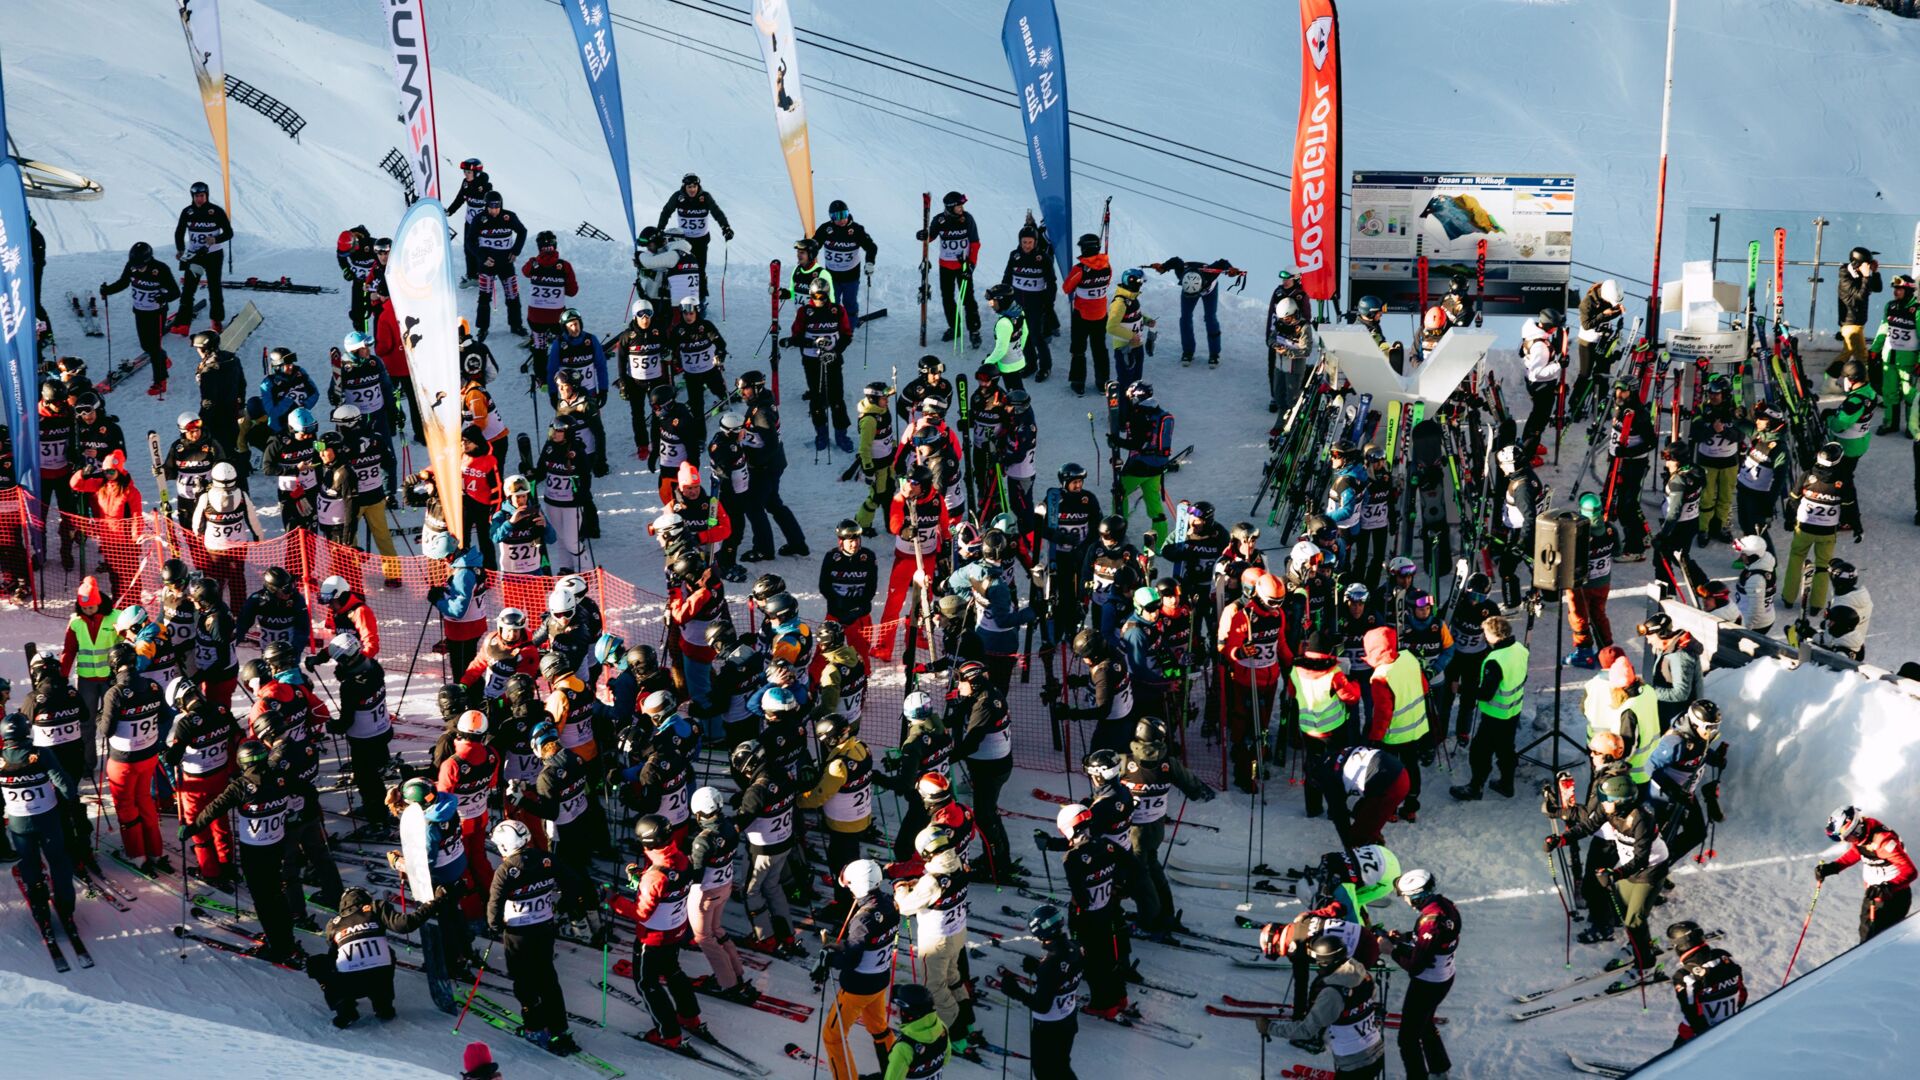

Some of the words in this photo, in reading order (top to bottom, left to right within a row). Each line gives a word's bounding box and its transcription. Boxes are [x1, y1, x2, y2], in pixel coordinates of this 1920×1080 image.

[1423, 176, 1436, 184] Der
[1438, 177, 1460, 185] Ozean
[680, 218, 706, 230] 253
[941, 239, 969, 251] 300
[824, 250, 854, 263] 353
[131, 290, 157, 303] 275
[531, 286, 561, 299] 239
[1672, 340, 1696, 350] Freude
[632, 356, 658, 369] 559
[684, 352, 711, 365] 273
[352, 386, 382, 403] 292
[959, 381, 968, 420] HEAD
[41, 442, 67, 457] 317
[351, 454, 381, 464] EMUS
[546, 476, 572, 491] 627
[1806, 502, 1837, 517] 526
[212, 522, 242, 538] 399
[129, 715, 159, 738] 195
[8, 786, 44, 803] 201
[341, 938, 382, 962] V111
